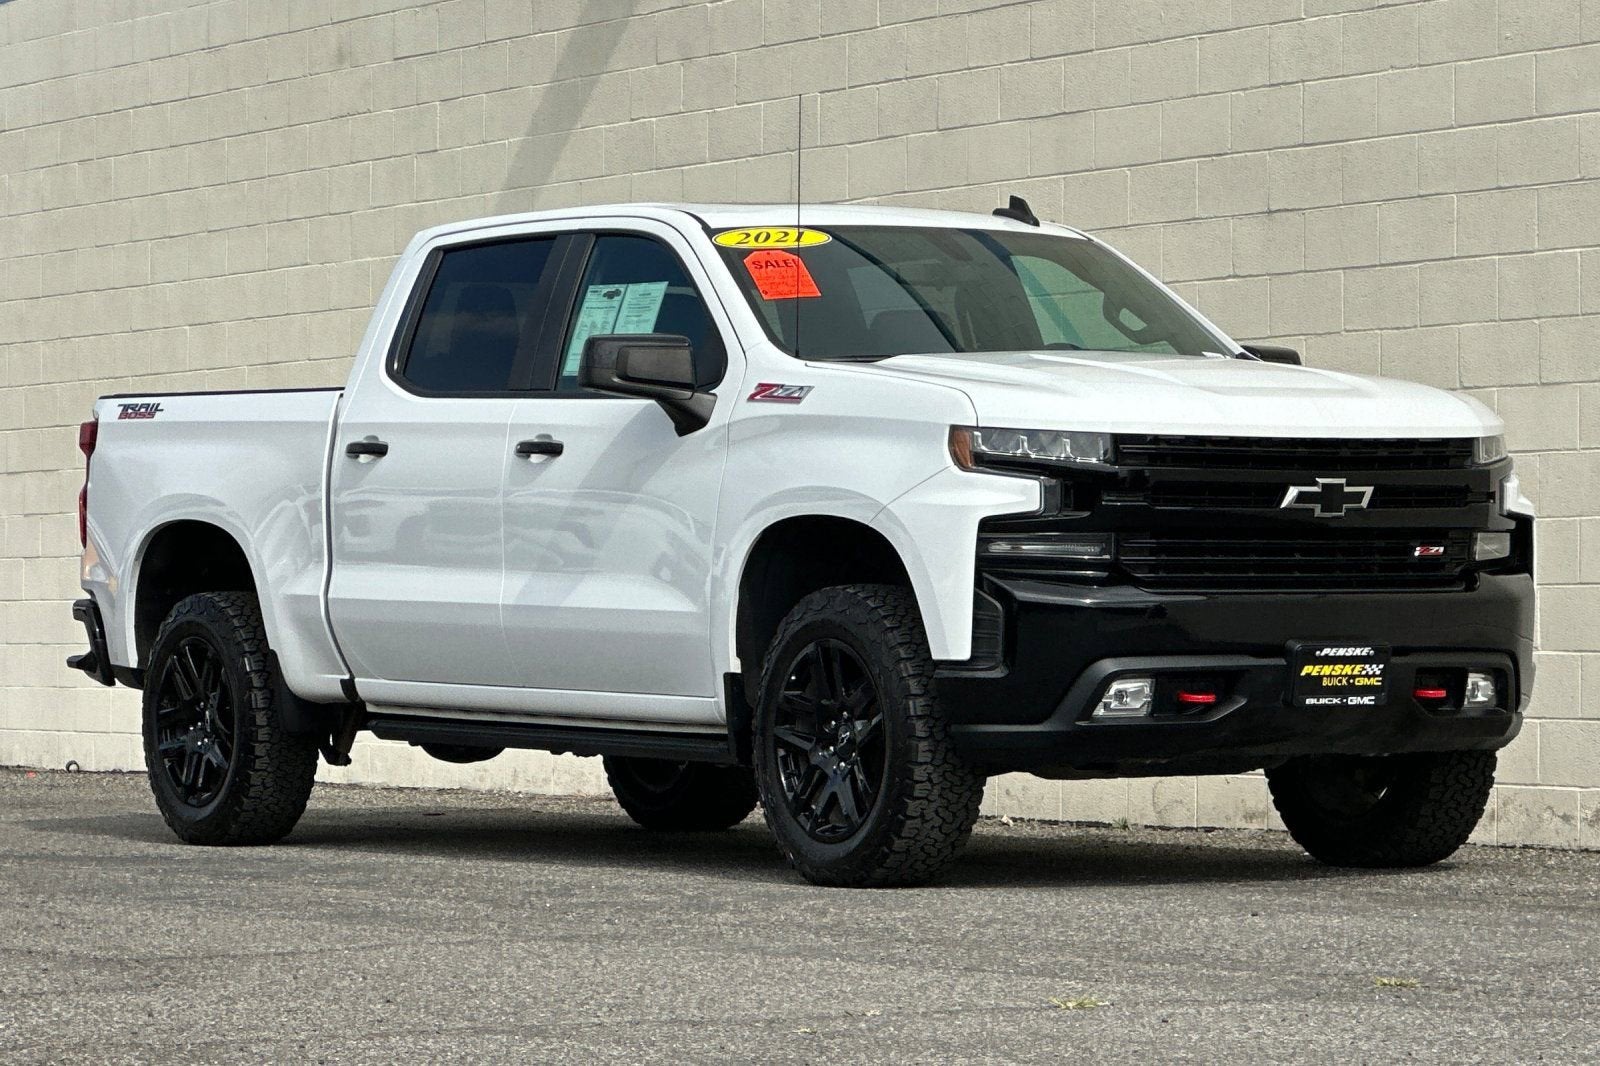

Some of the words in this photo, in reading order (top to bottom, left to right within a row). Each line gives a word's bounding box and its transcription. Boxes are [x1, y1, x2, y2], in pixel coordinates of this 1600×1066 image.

[735, 231, 805, 244] 2021
[747, 382, 815, 405] Z71
[117, 402, 164, 413] TRAIL
[118, 411, 157, 420] BOSS
[1320, 647, 1372, 656] PENSKE
[1300, 664, 1365, 676] PENSKE
[1322, 677, 1348, 686] BUICK
[1354, 677, 1382, 686] GMC
[1305, 697, 1341, 705] BUICK
[1347, 696, 1375, 705] GMC
